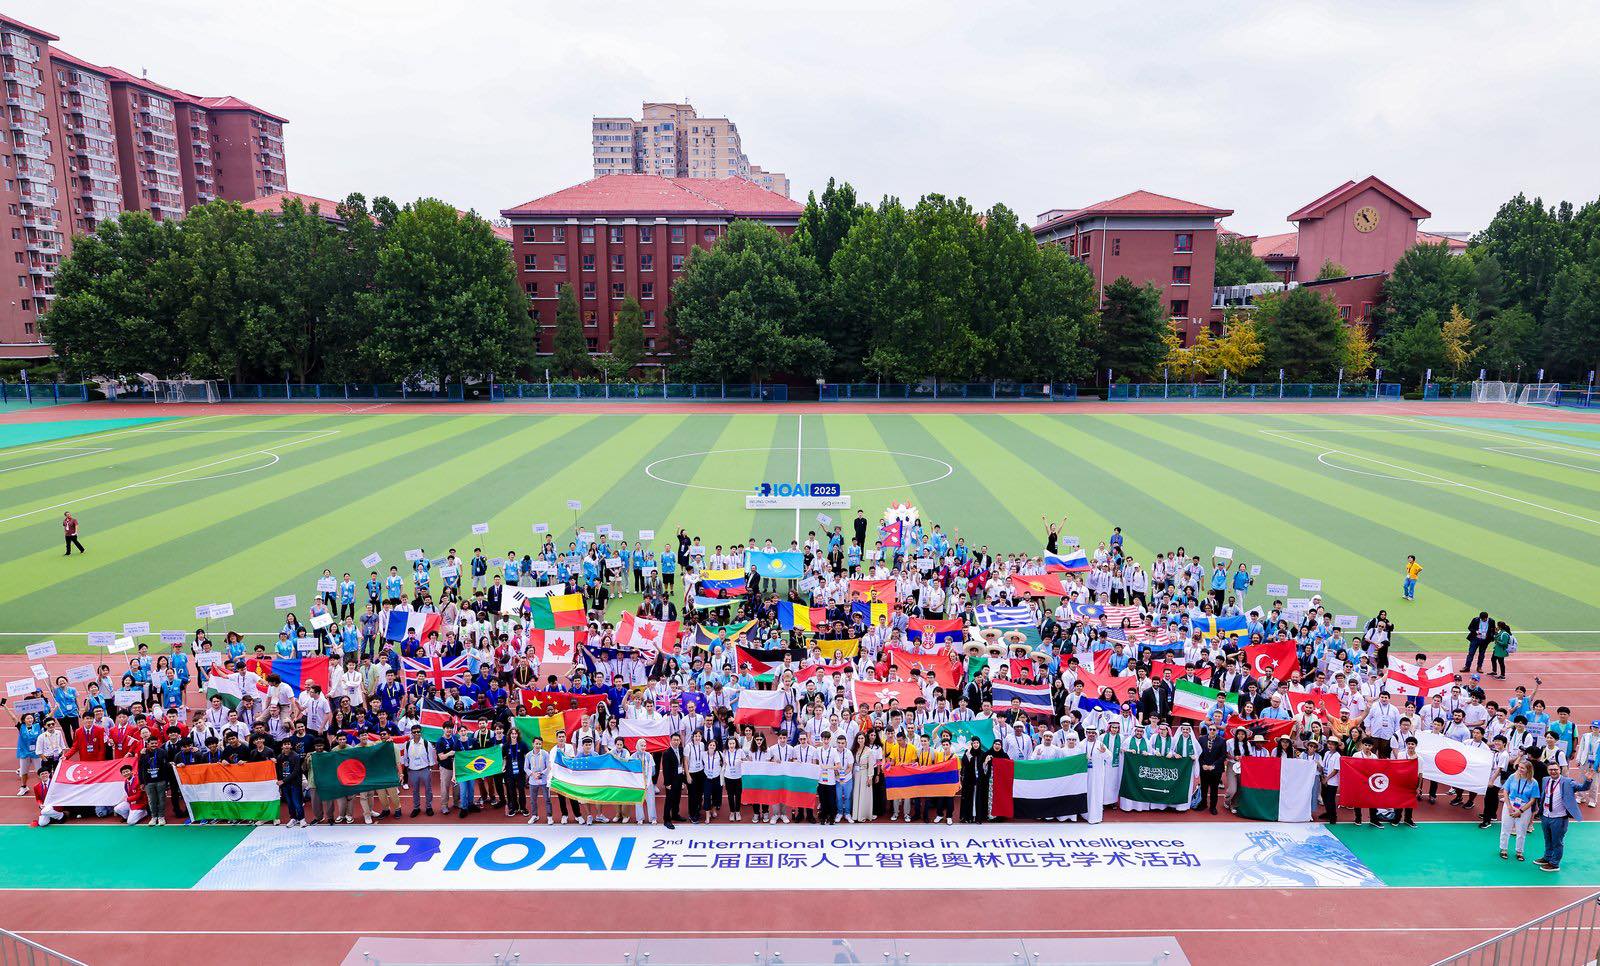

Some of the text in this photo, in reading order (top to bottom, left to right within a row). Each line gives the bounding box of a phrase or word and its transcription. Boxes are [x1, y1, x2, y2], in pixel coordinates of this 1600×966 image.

[773, 484, 837, 497] IOAI 2025
[652, 837, 1185, 851] 2nd International Olympiad in Artificial Intelligence
[441, 837, 636, 871] IOAI
[644, 851, 1202, 869] 第二届国际人工智能奥林匹克学术活动
